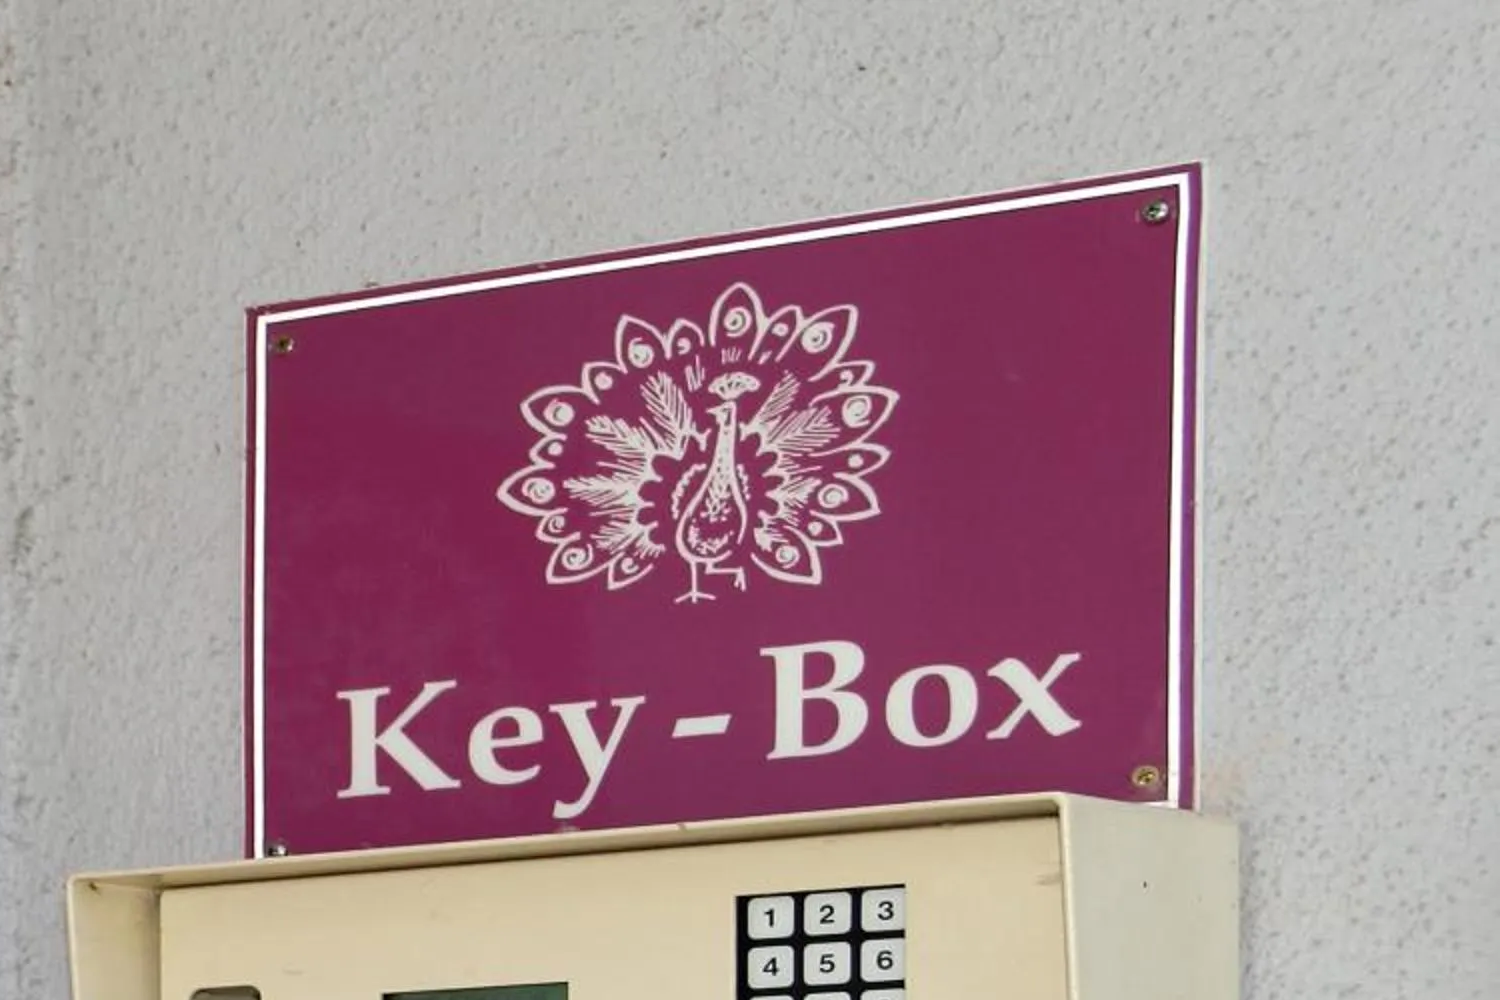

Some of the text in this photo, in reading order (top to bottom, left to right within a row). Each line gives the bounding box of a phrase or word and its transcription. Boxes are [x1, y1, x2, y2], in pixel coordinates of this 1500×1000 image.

[337, 680, 645, 818] Key
[760, 641, 1081, 759] Box
[764, 901, 894, 928] 1 2 3
[762, 950, 894, 977] 4 5 6
